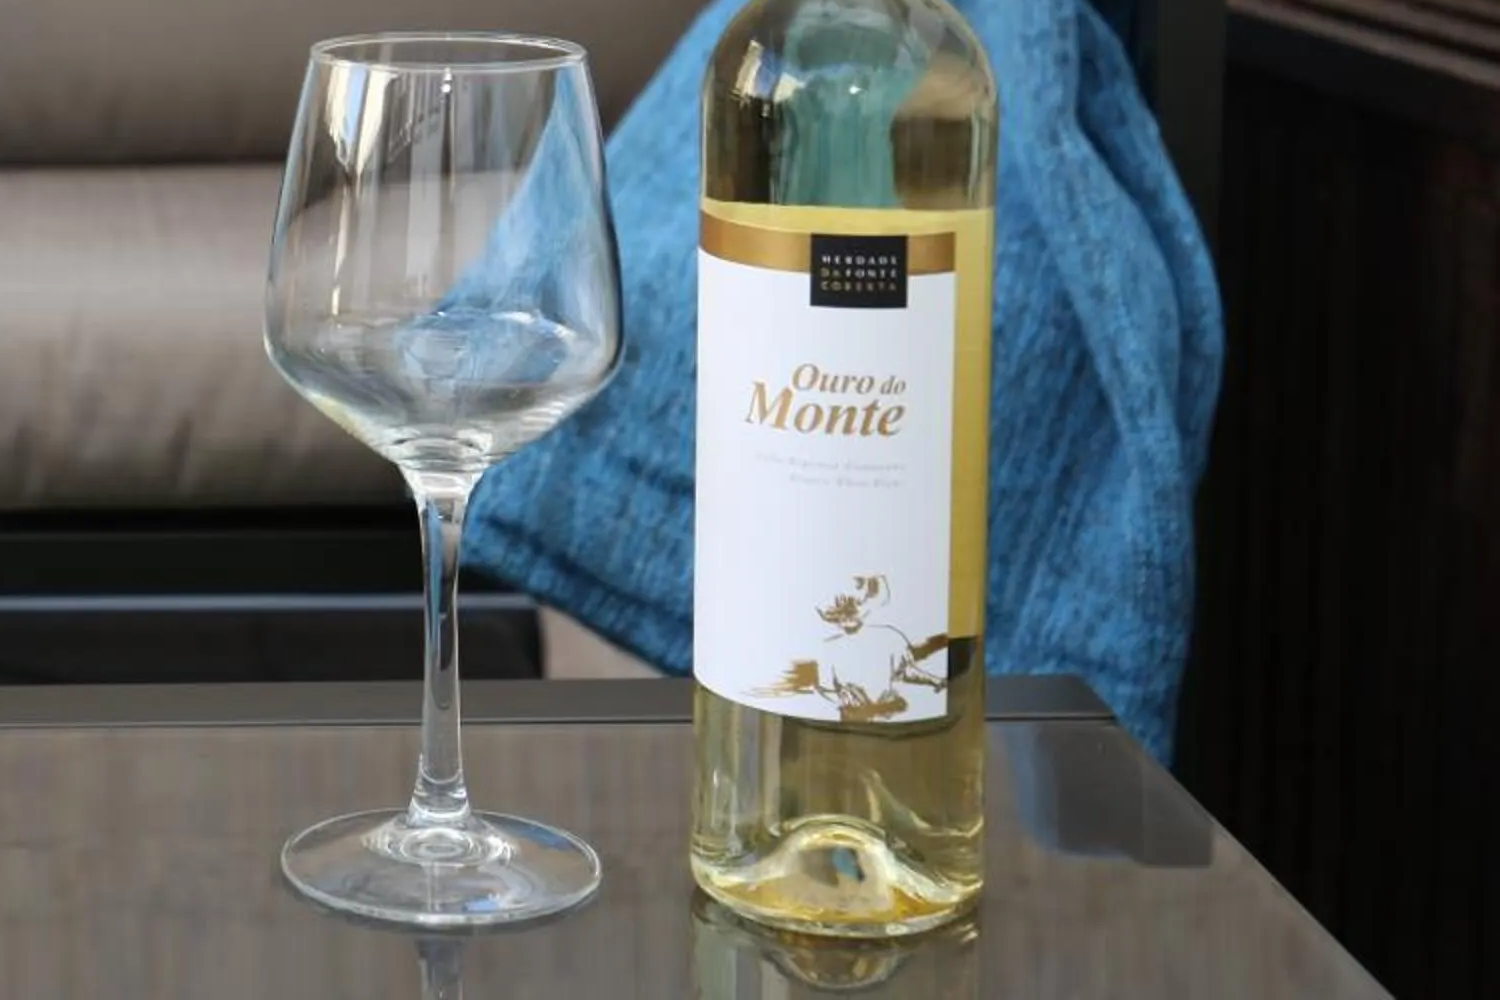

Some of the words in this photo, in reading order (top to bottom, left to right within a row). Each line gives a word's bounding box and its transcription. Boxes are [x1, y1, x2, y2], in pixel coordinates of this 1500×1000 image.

[821, 254, 898, 265] HERDADE
[820, 281, 897, 291] COBERTA
[792, 363, 875, 396] Ouro
[881, 373, 907, 396] do
[744, 380, 906, 438] Monte
